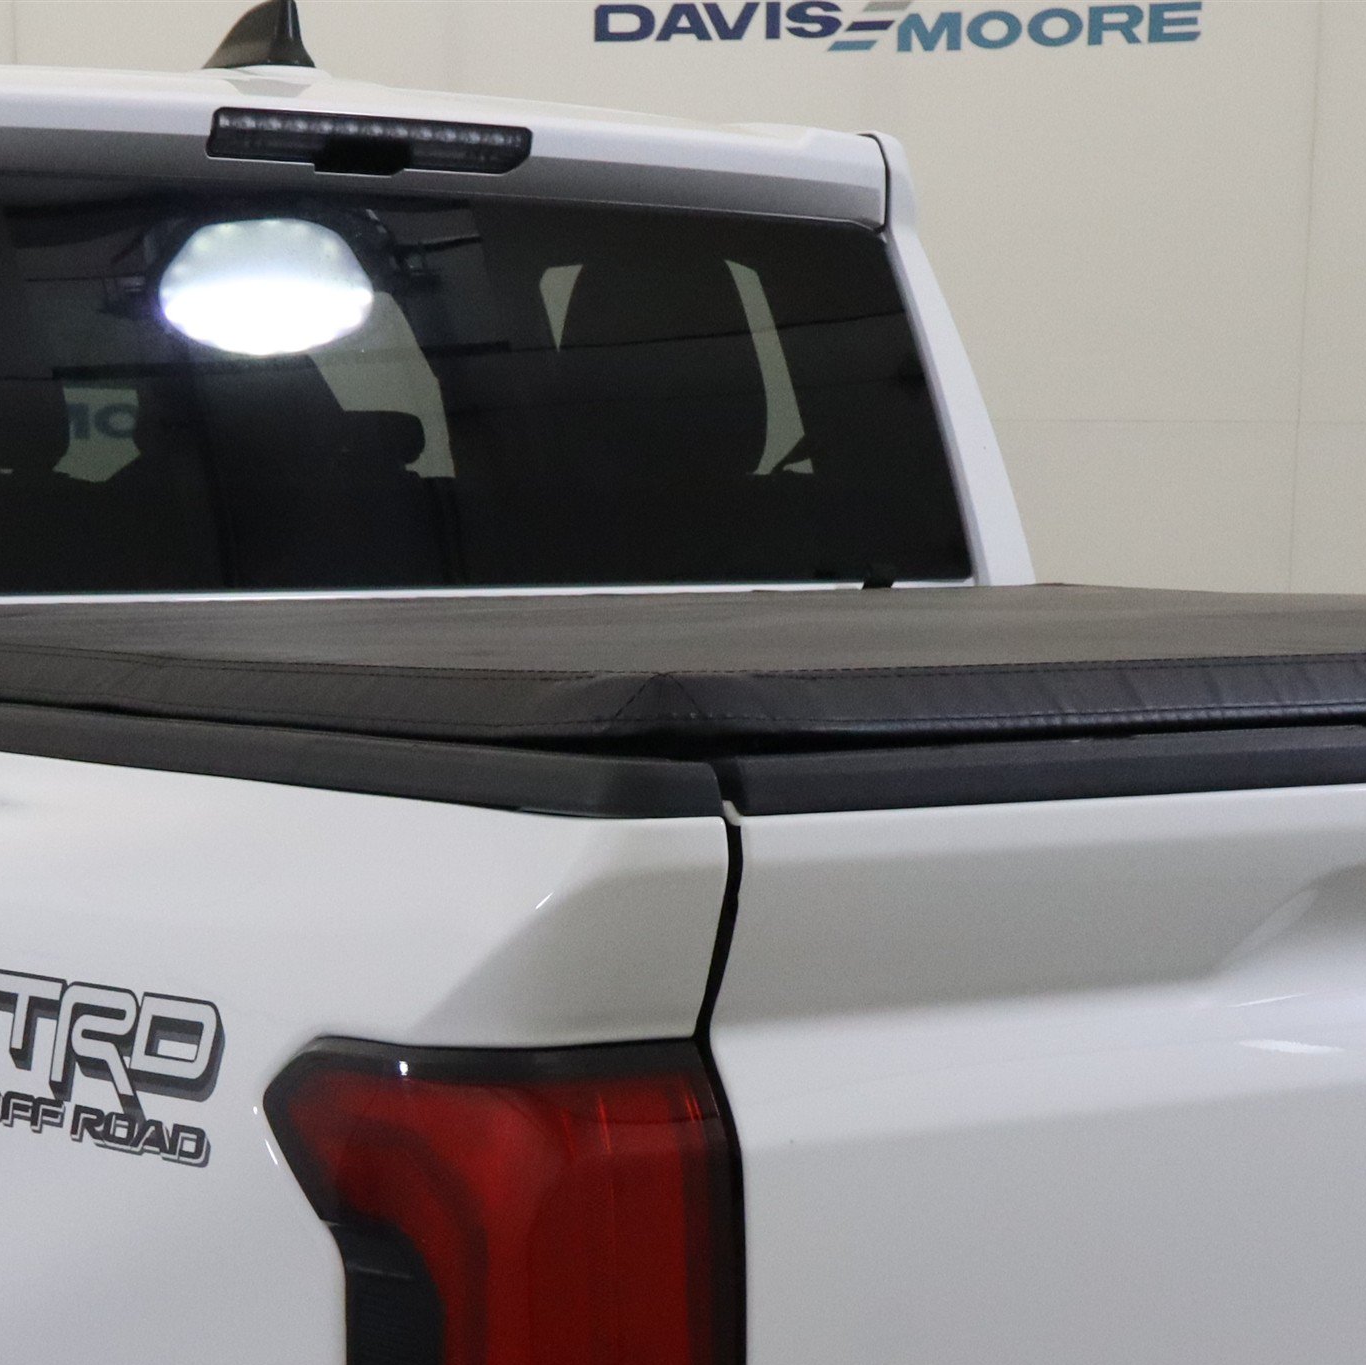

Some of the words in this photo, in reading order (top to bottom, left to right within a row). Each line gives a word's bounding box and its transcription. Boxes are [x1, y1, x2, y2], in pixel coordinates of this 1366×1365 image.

[593, 1, 843, 43] DAVIS
[894, 1, 1203, 53] MOORE
[70, 1104, 212, 1168] ROAD
